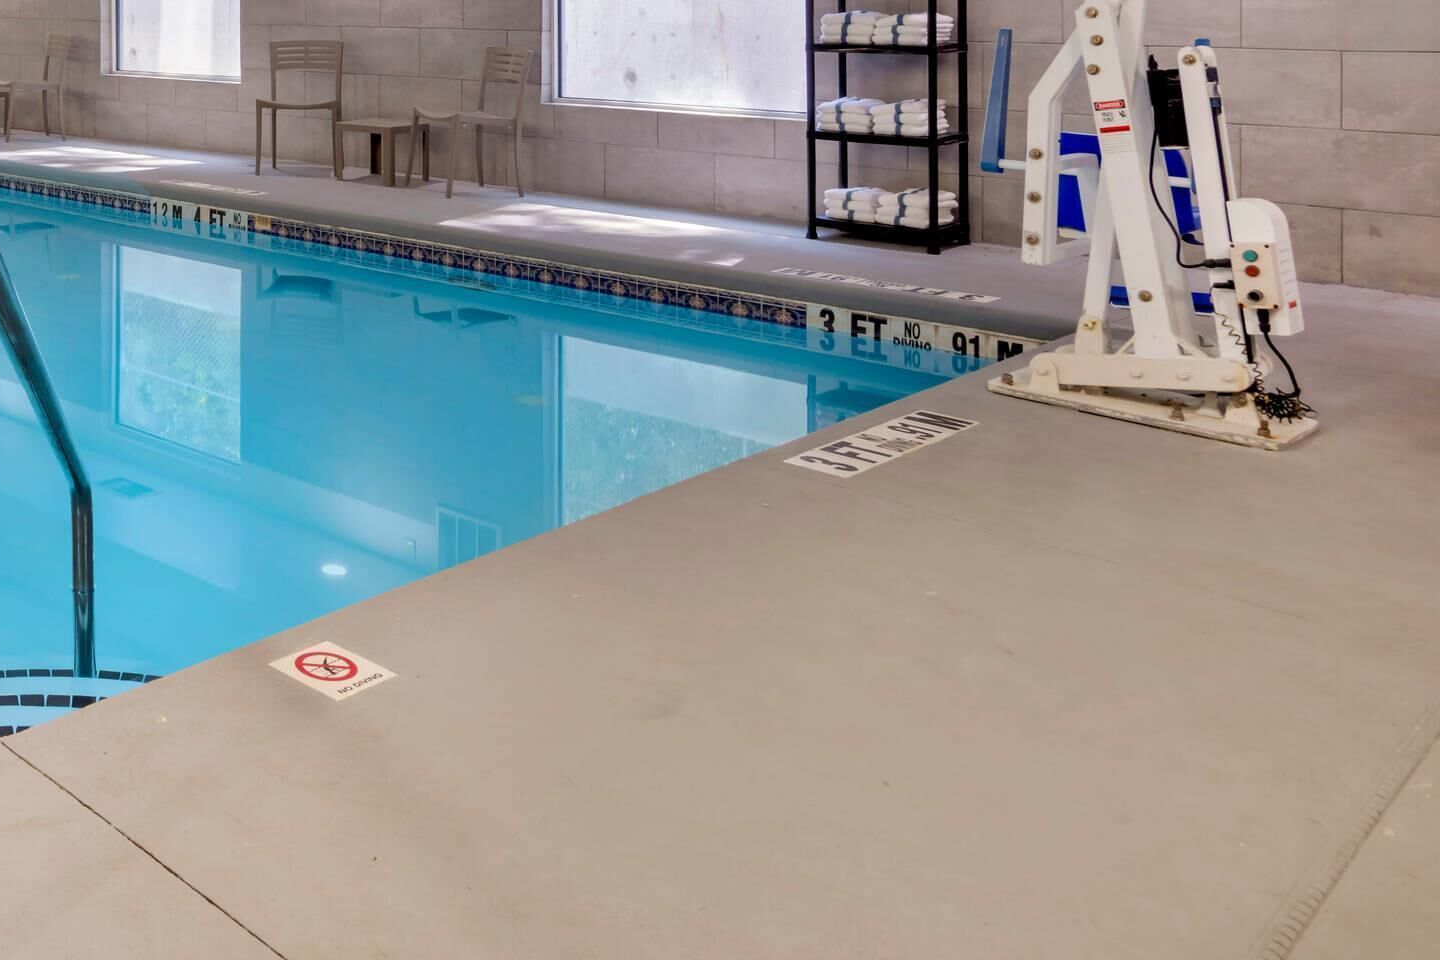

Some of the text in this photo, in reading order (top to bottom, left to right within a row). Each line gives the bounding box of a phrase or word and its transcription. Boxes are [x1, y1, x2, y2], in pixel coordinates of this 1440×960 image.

[172, 205, 182, 219] M
[209, 209, 226, 227] FT
[819, 308, 835, 333] 3
[851, 313, 888, 341] FT
[997, 341, 1023, 362] M
[905, 321, 920, 339] NO
[904, 411, 975, 431] M
[819, 441, 893, 464] FT
[799, 455, 859, 472] 3
[337, 673, 383, 694] NO DIVING
